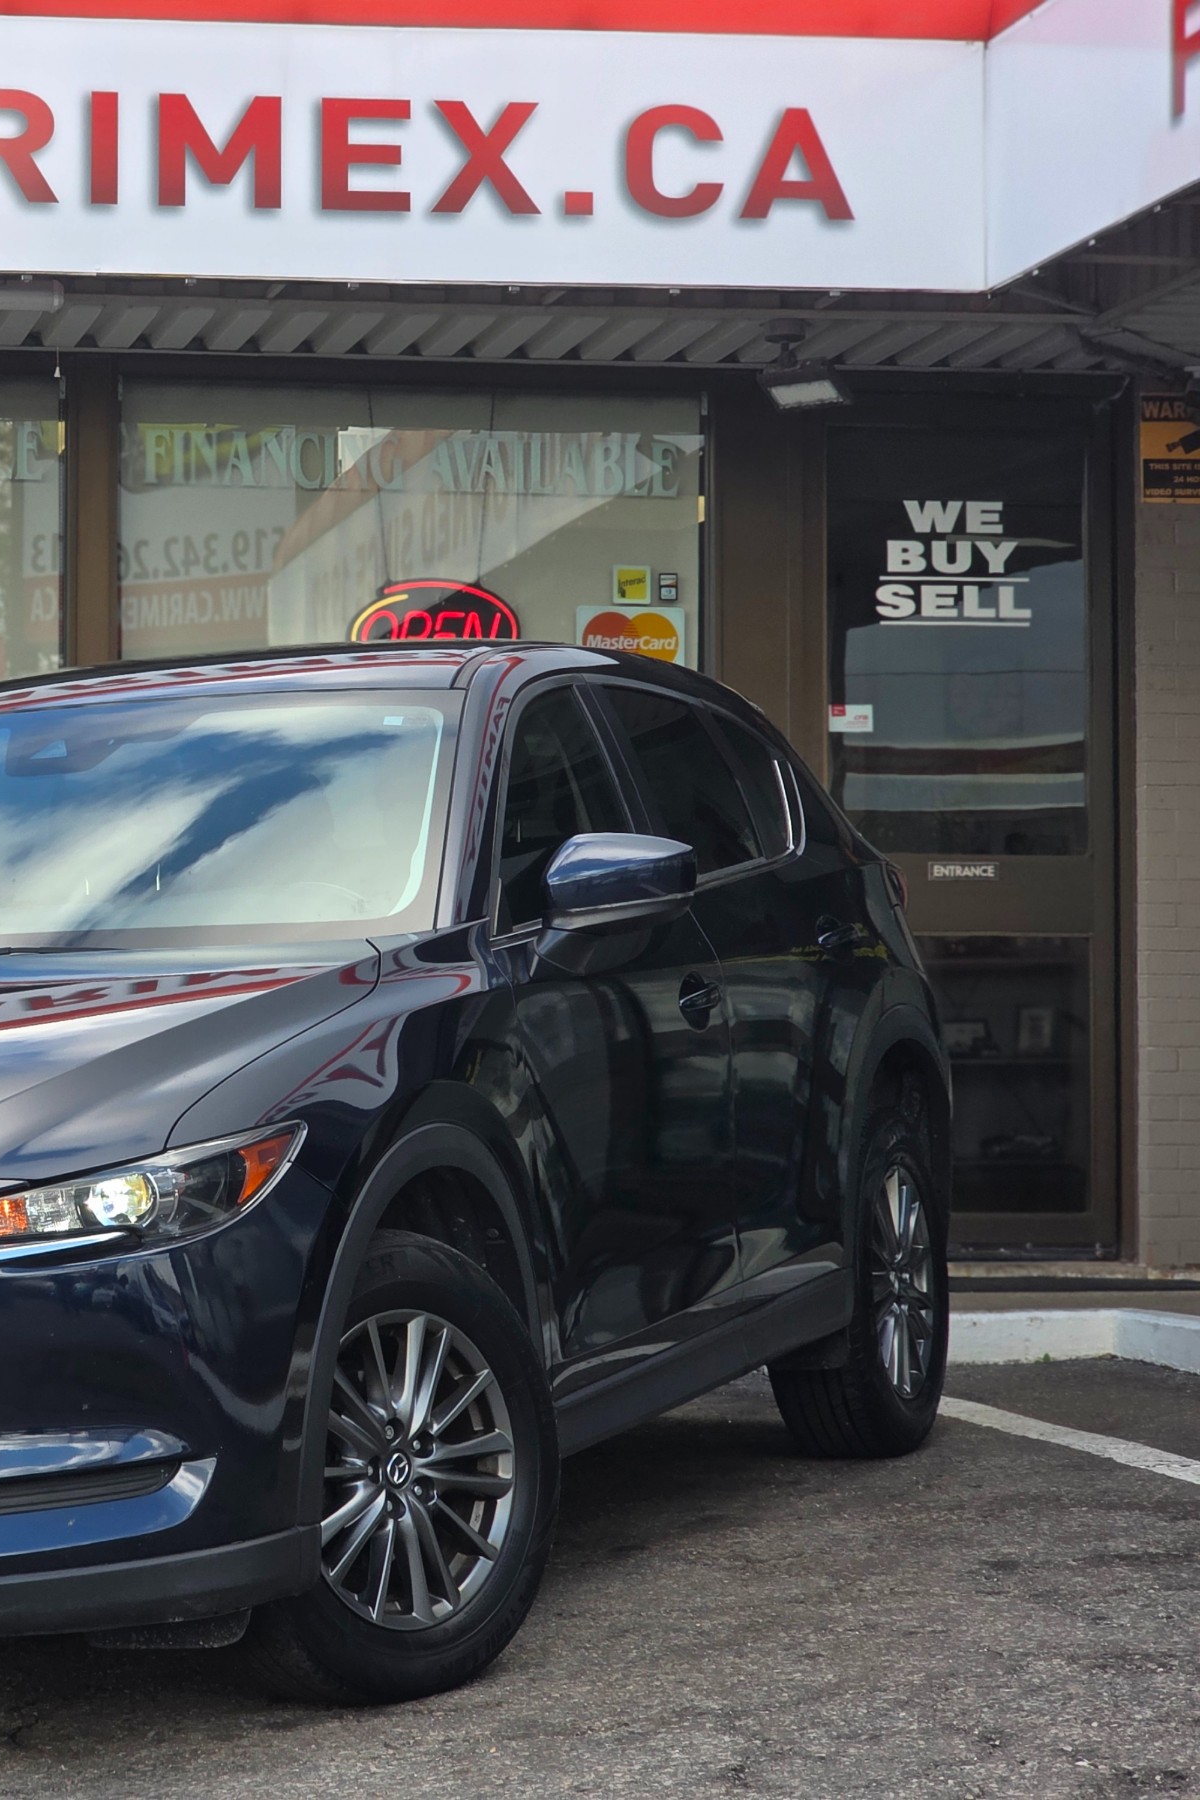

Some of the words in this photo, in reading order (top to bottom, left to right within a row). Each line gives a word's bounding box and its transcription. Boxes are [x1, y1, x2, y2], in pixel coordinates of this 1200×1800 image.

[1143, 401, 1188, 419] WAR
[144, 428, 406, 490] FINANCING
[430, 434, 679, 497] AVAILABLE
[1174, 488, 1200, 496] SURV
[903, 500, 1003, 533] WE
[887, 540, 1018, 574] BUY
[875, 584, 1032, 618] SELL
[586, 634, 676, 650] MasterCard
[933, 865, 995, 877] ENTRANCE
